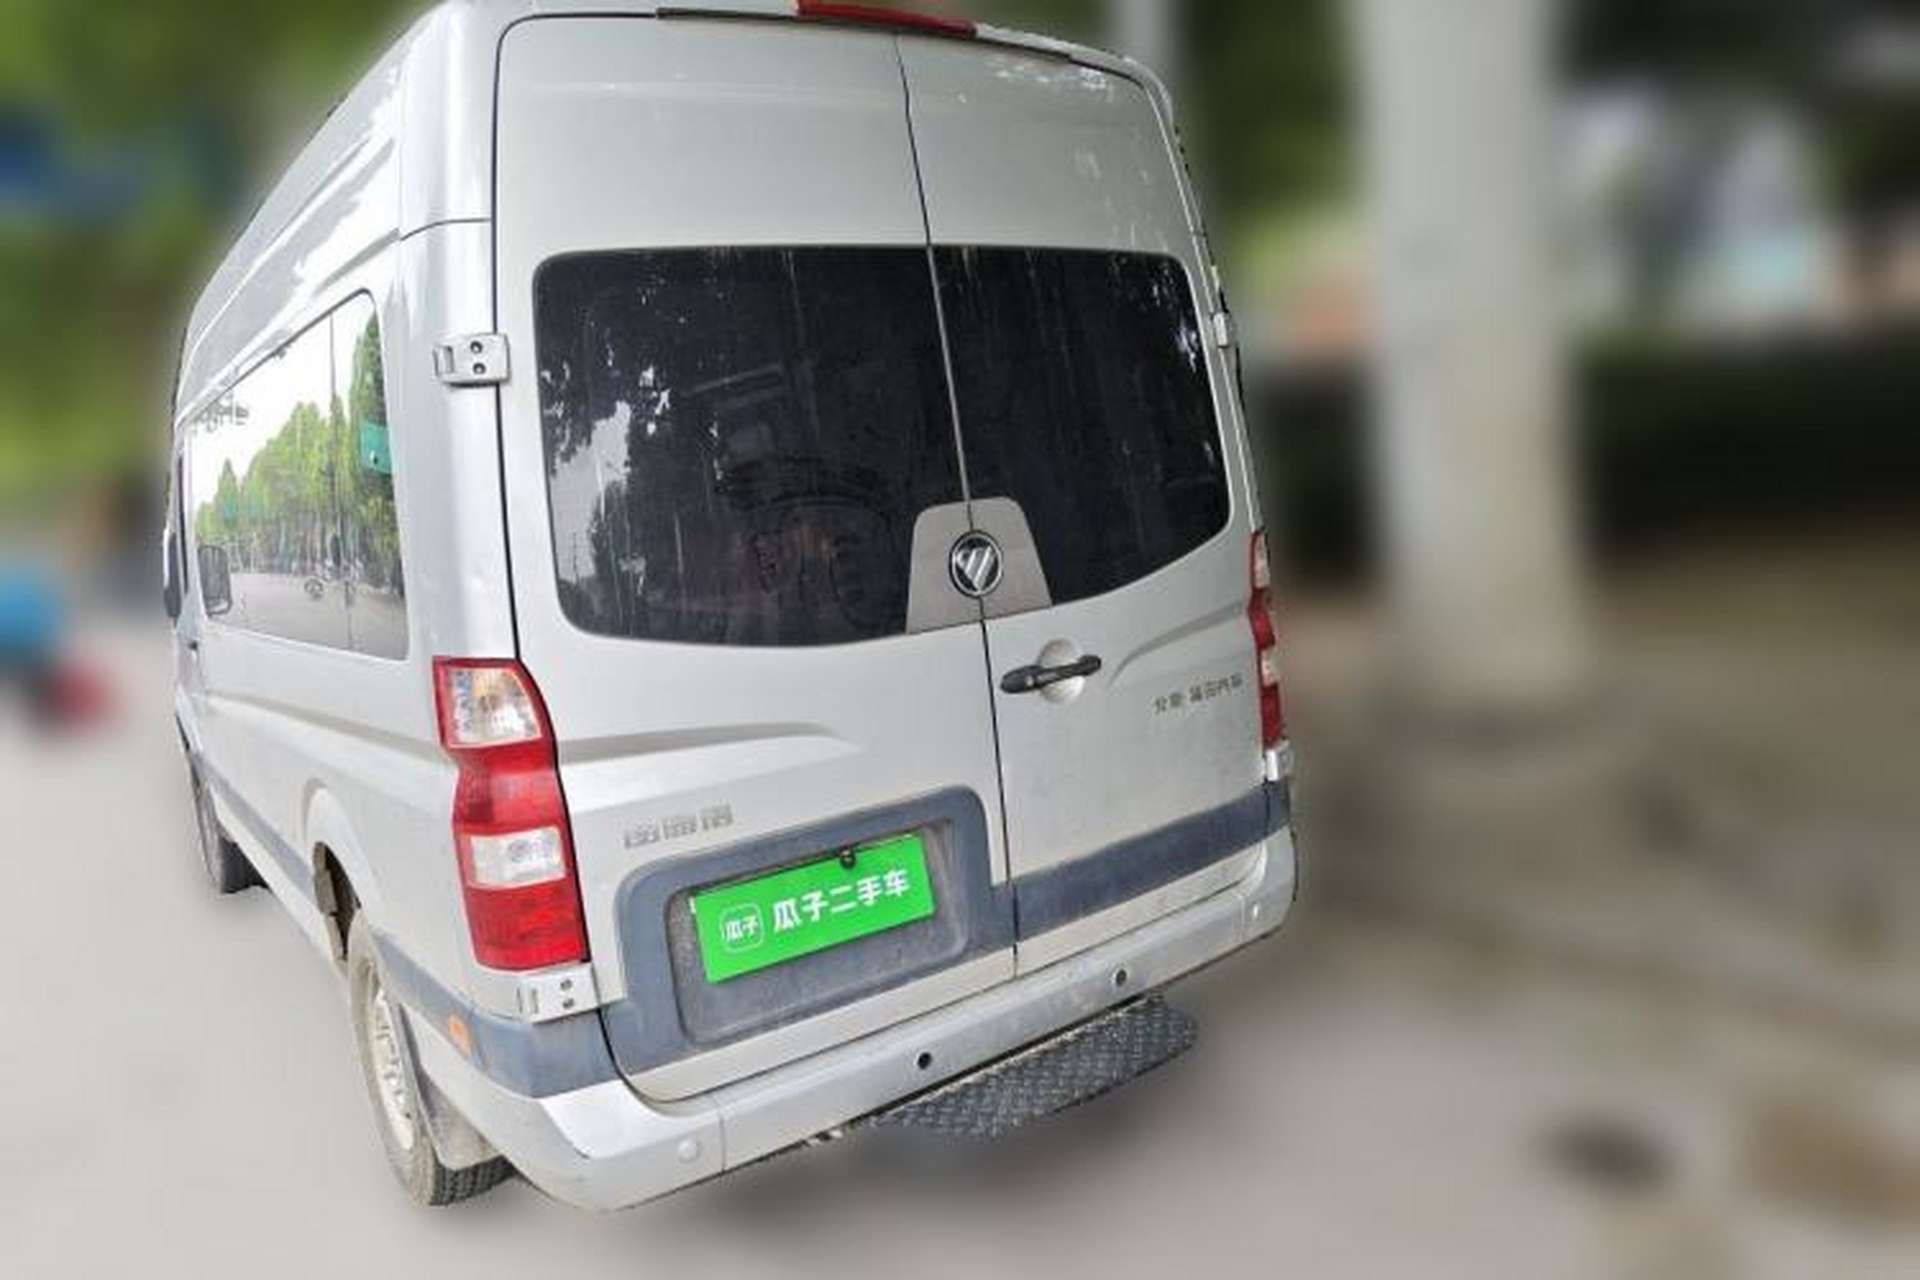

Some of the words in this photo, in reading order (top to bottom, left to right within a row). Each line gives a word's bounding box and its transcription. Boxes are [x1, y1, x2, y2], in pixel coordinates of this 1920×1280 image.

[774, 869, 910, 932] 瓜子二手车
[723, 916, 759, 943] 瓜子
